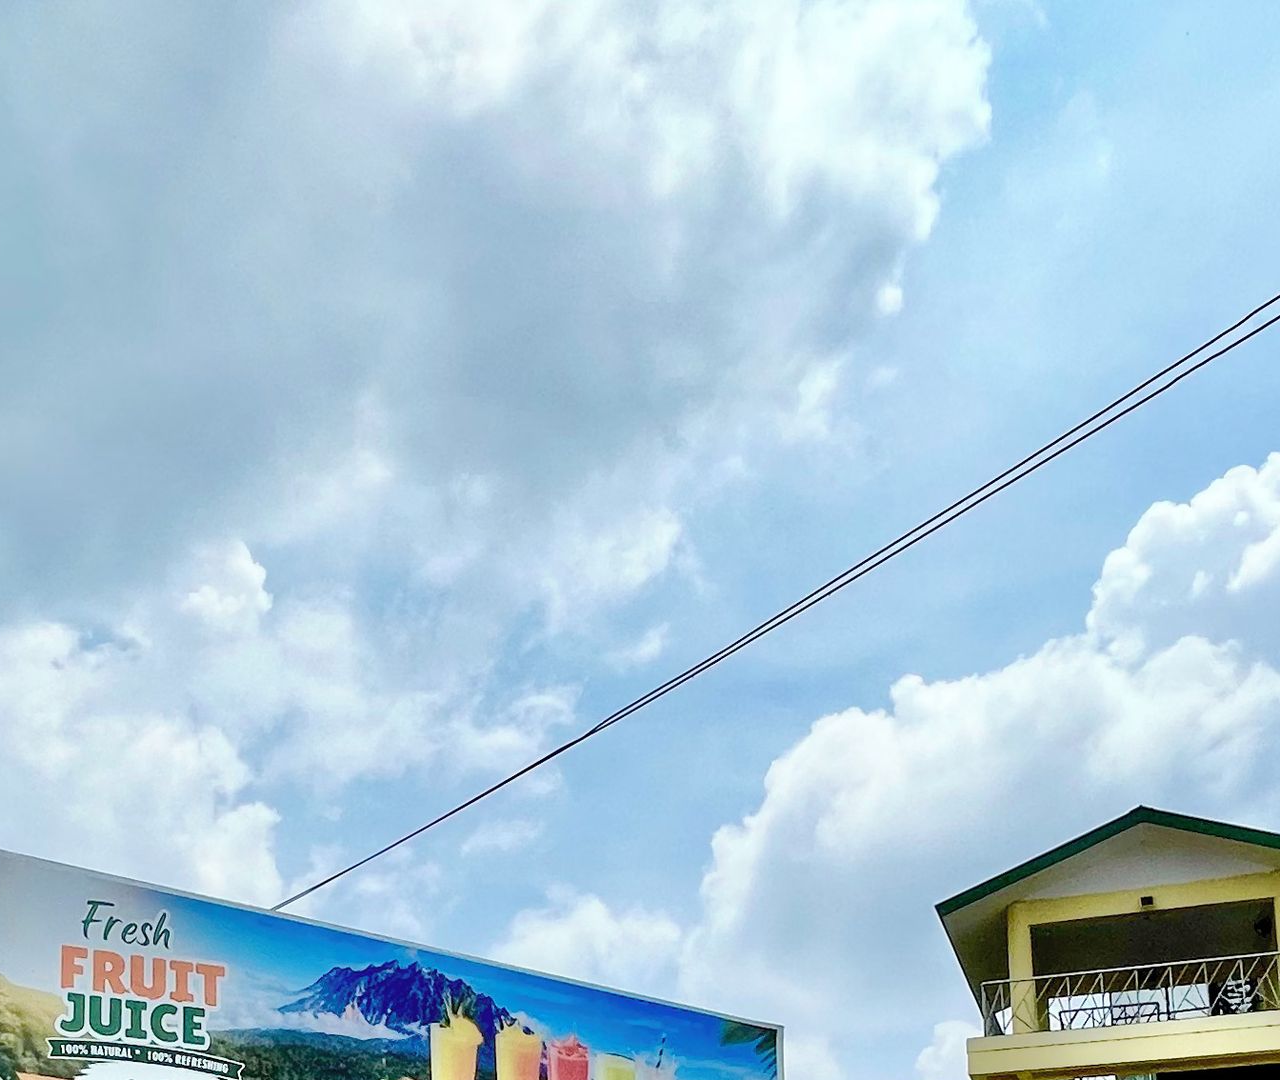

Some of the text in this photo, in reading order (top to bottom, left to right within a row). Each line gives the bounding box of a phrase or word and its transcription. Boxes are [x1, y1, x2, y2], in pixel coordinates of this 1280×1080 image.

[81, 900, 171, 949] Fresh
[60, 944, 225, 1007] FRUIT
[60, 992, 205, 1045] JUICE
[60, 1044, 132, 1059] 100% NATURAL
[147, 1050, 229, 1074] 100% REFRESHING
